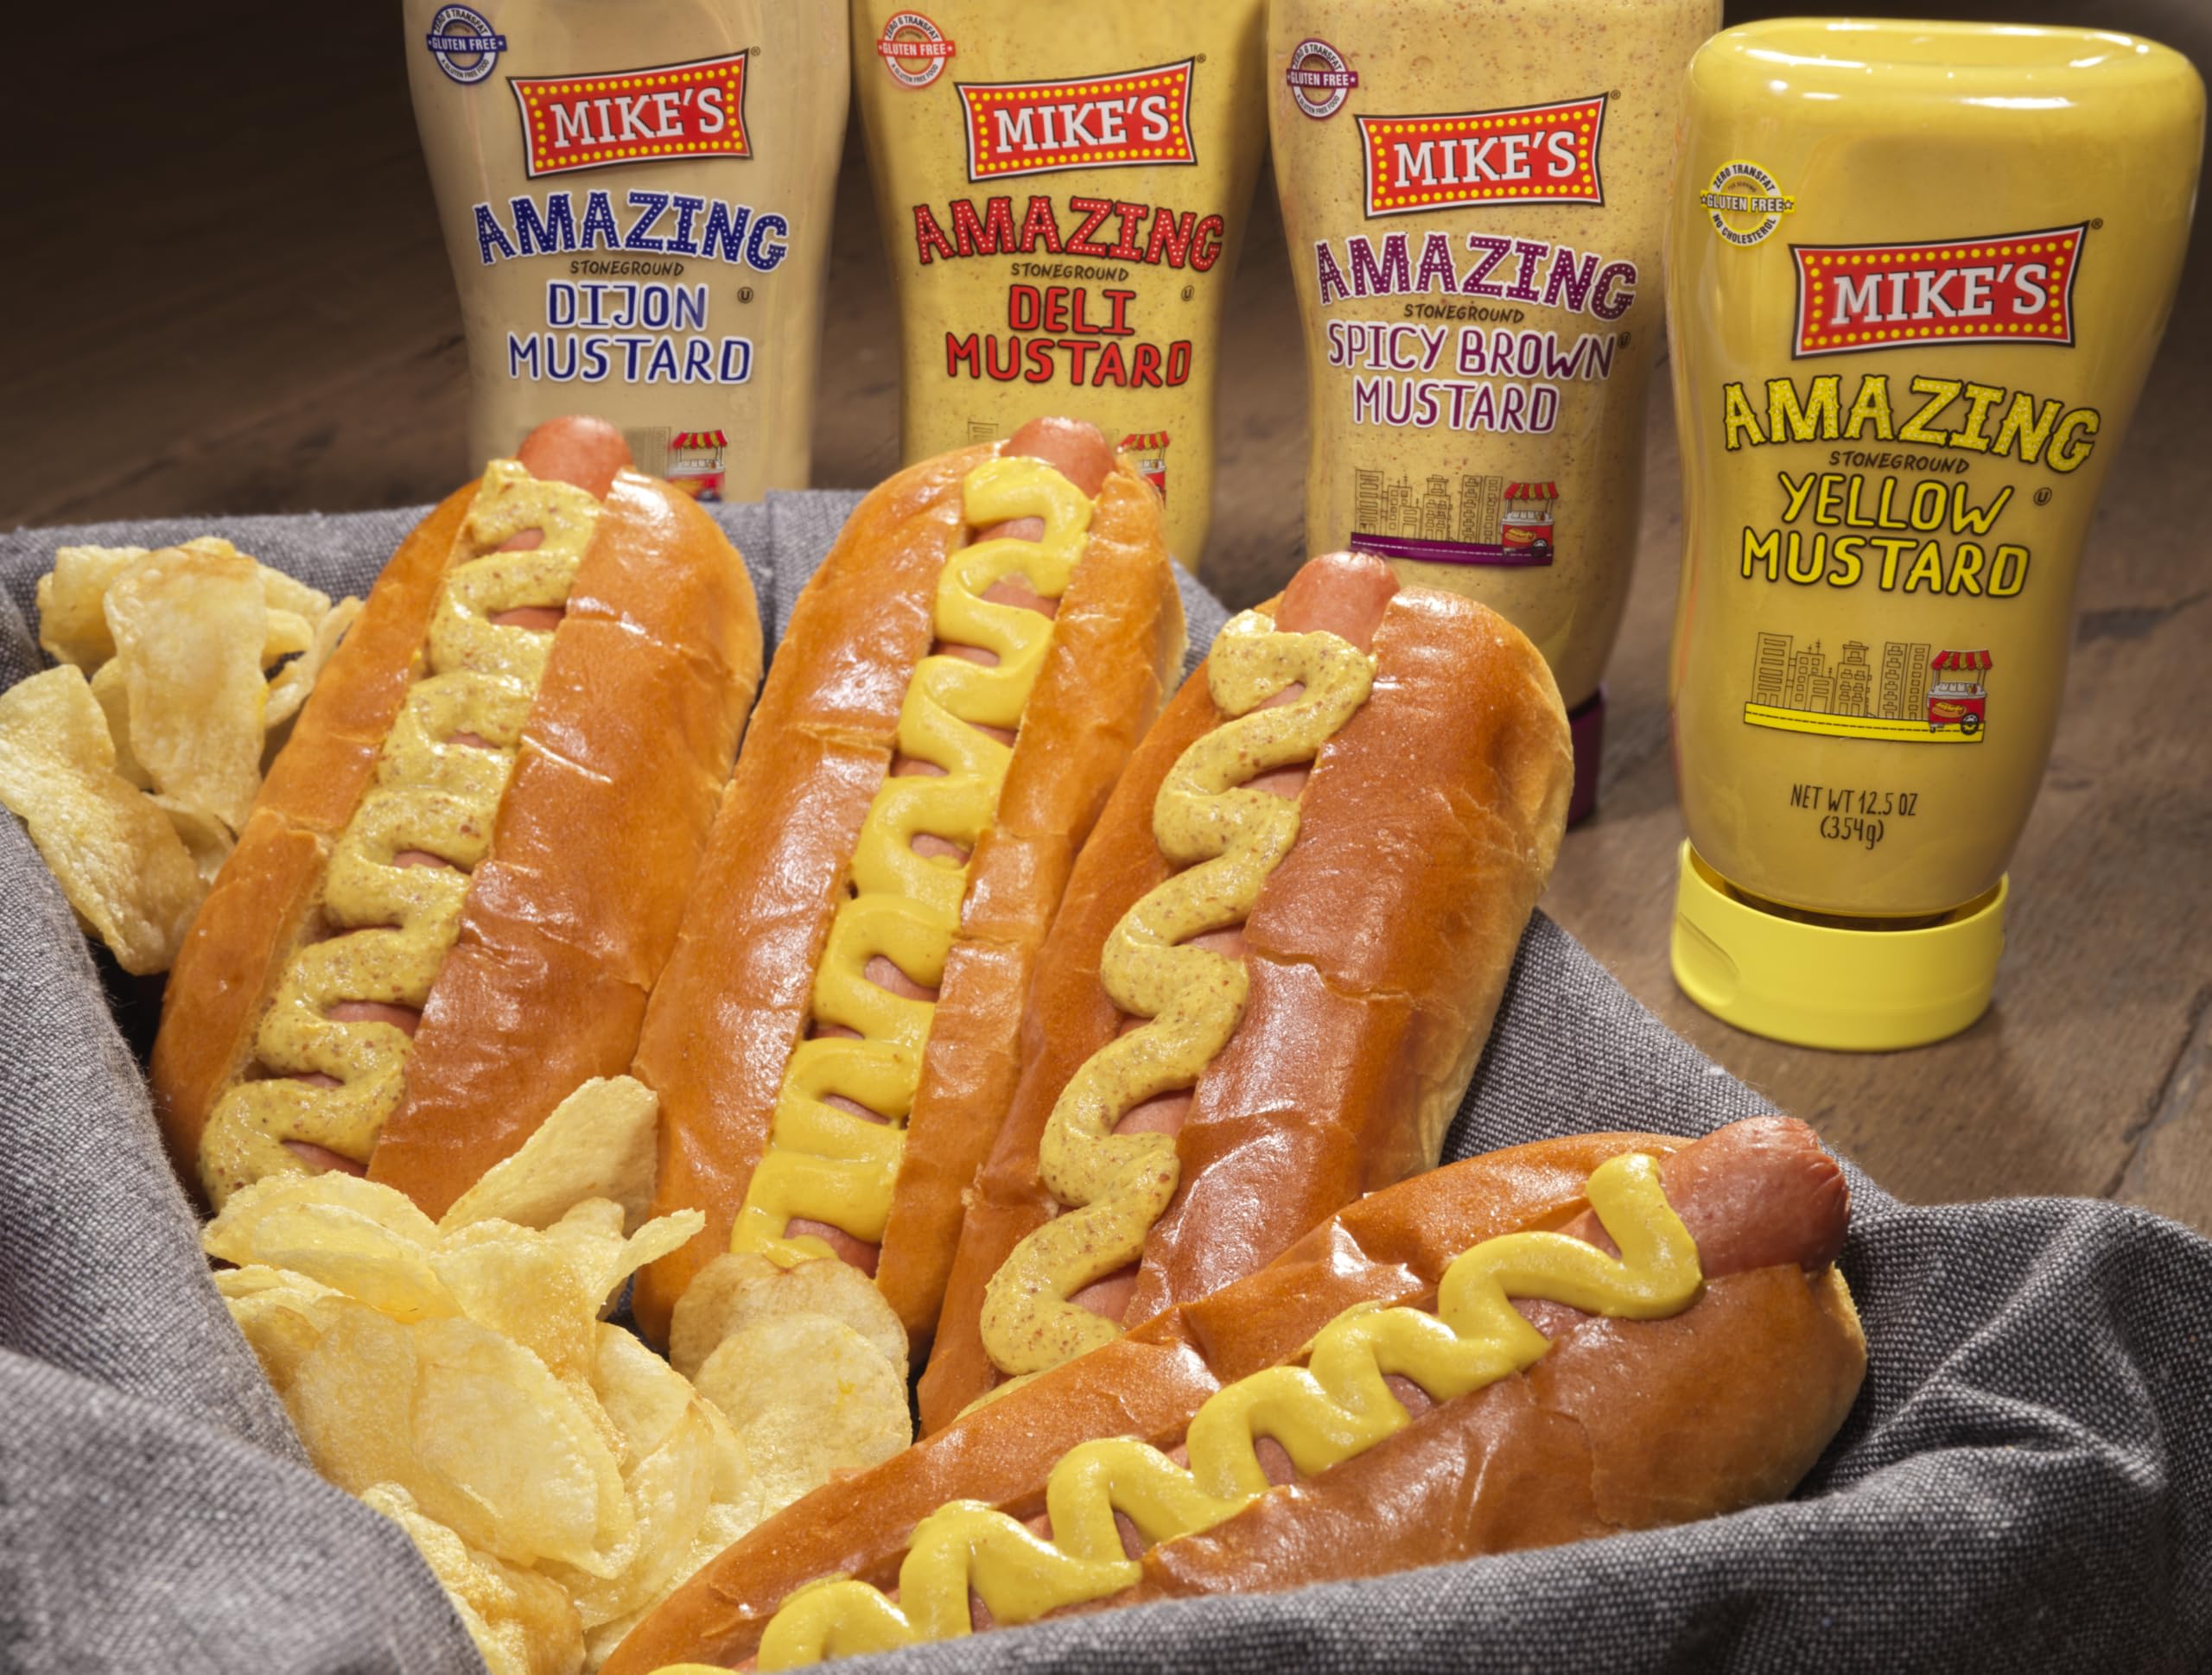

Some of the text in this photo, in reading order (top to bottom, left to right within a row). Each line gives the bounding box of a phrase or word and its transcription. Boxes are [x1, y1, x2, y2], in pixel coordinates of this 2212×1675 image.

[432, 37, 497, 51] GLUTEN FREE
[882, 42, 946, 56] GLUTEN FREE
[903, 16, 939, 40] TRANSFAT
[1290, 72, 1349, 86] GLUTEN FREE
[1309, 44, 1343, 70] TRANSFAT
[550, 87, 726, 148] MIKE'S
[994, 94, 1171, 154] MIKE'S
[1393, 130, 1578, 188] MIKE'S
[1713, 168, 1732, 189] ZERO
[1732, 164, 1777, 191] TRANSFAT
[1707, 193, 1784, 213] GLUTEN FREE
[1713, 213, 1777, 244] NO CHOLESTEROL
[474, 190, 789, 272] AMAZING
[912, 196, 1225, 272] AMAZING
[570, 260, 685, 277] STONEGROUND
[1010, 262, 1129, 282] STONEGROUND
[1314, 232, 1638, 321] AMAZING
[546, 280, 709, 331] DIJON
[1008, 284, 1136, 335] DELI
[1403, 302, 1525, 325] STONEGROUND
[1829, 263, 2048, 326] MIKE'S
[507, 332, 754, 384] MUSTARD
[945, 333, 1193, 388] MUSTARD
[1327, 320, 1618, 380] SPICY BROWN
[1352, 375, 1560, 434] MUSTARD
[1724, 374, 2101, 473] AMAZING
[1828, 450, 1970, 474] STONEGROUND
[1778, 471, 2015, 535] YELLOW
[1741, 526, 2031, 598] MUSTARD
[1790, 783, 1918, 816] NET WT 12.5 OZ
[1820, 815, 1885, 851] (354g)
